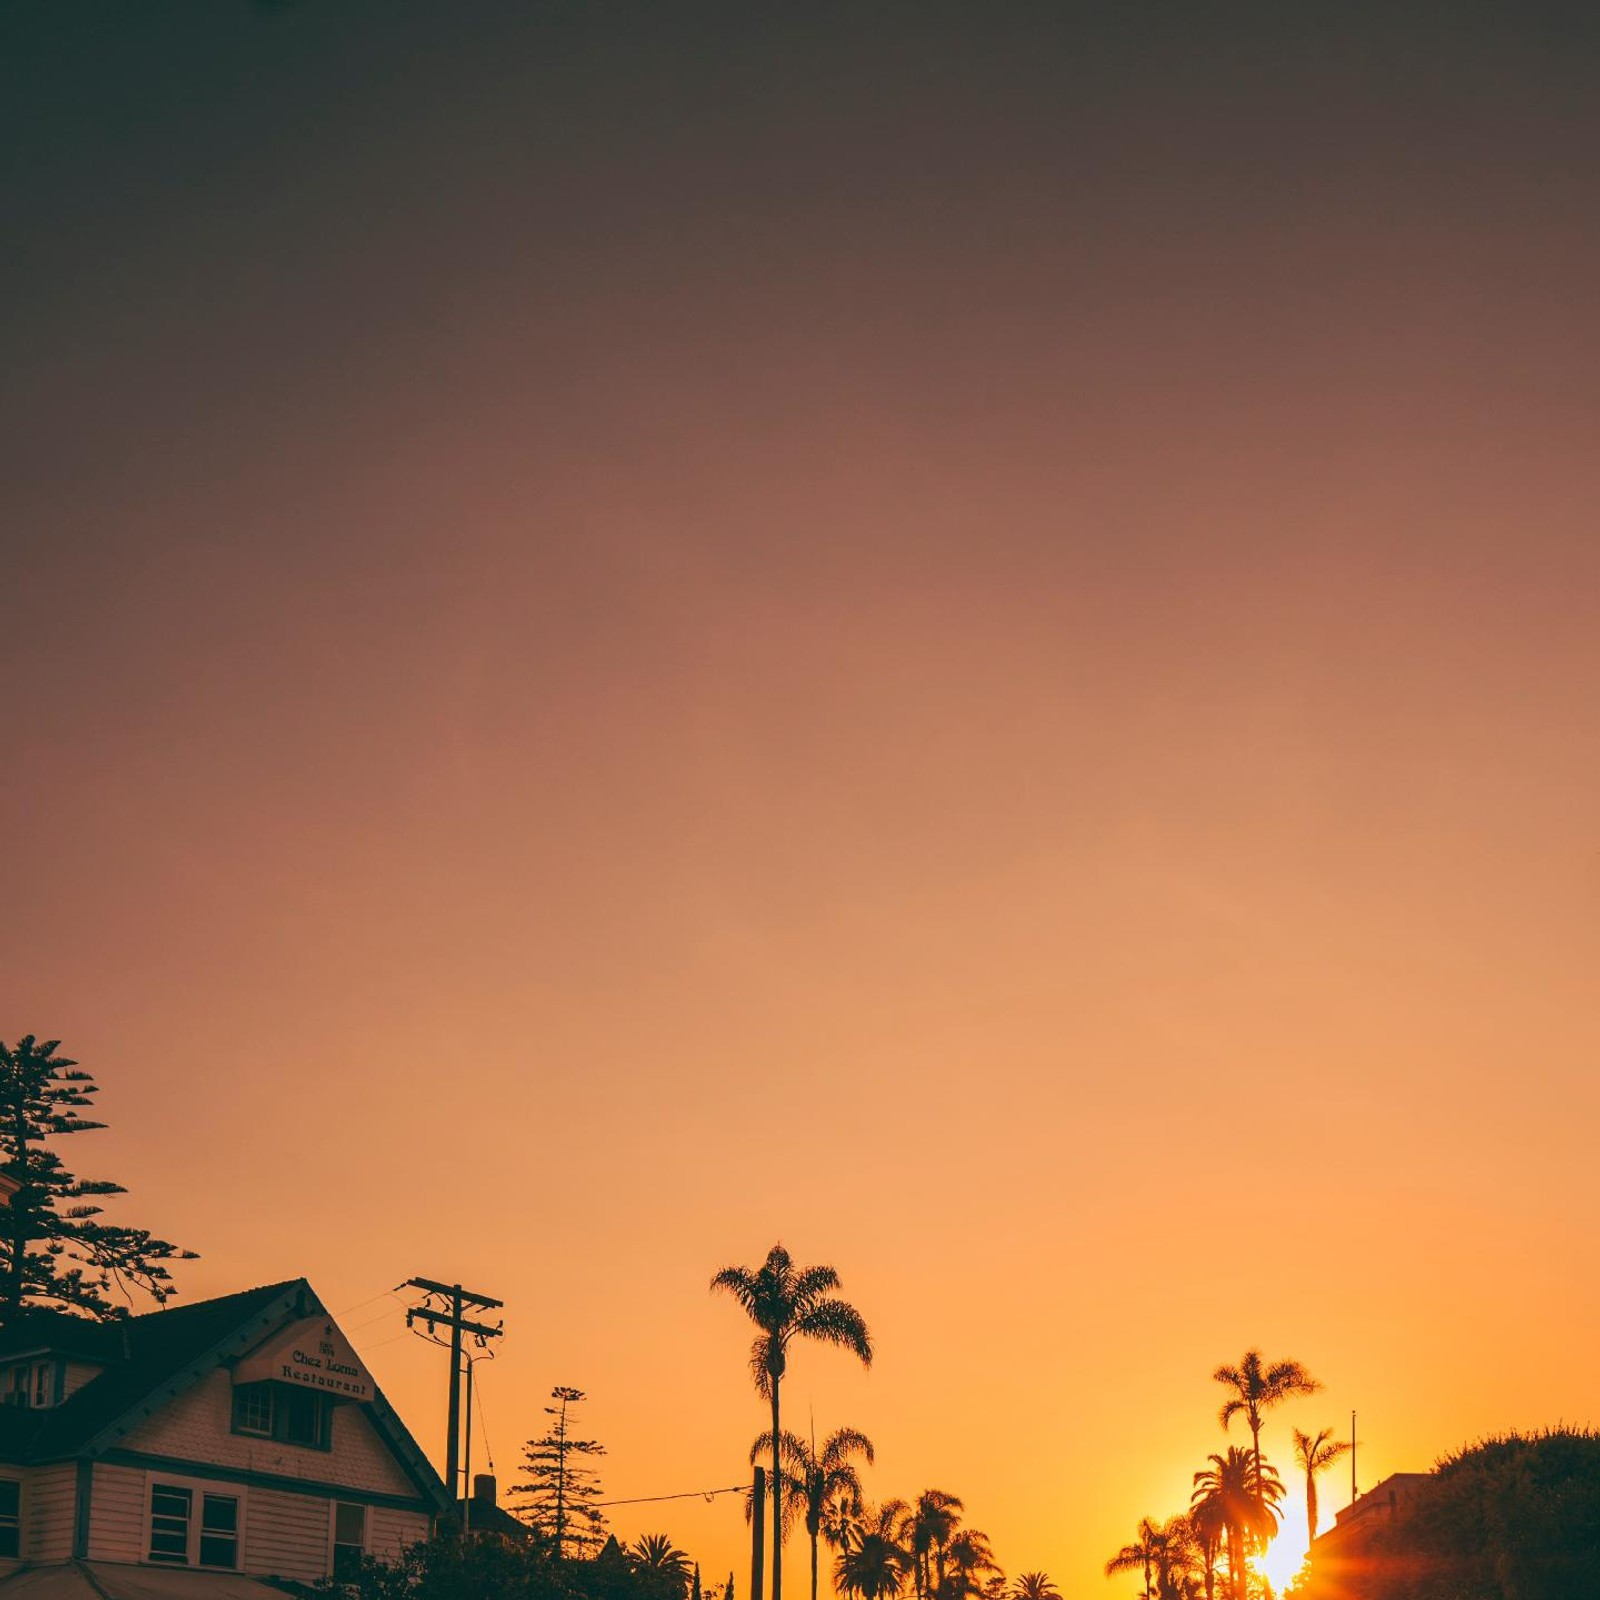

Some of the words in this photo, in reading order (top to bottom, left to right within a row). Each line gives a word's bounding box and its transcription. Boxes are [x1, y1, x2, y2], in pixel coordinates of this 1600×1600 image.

[292, 1350, 321, 1368] Chez
[326, 1358, 359, 1377] Loma
[282, 1365, 366, 1395] Restaurant
